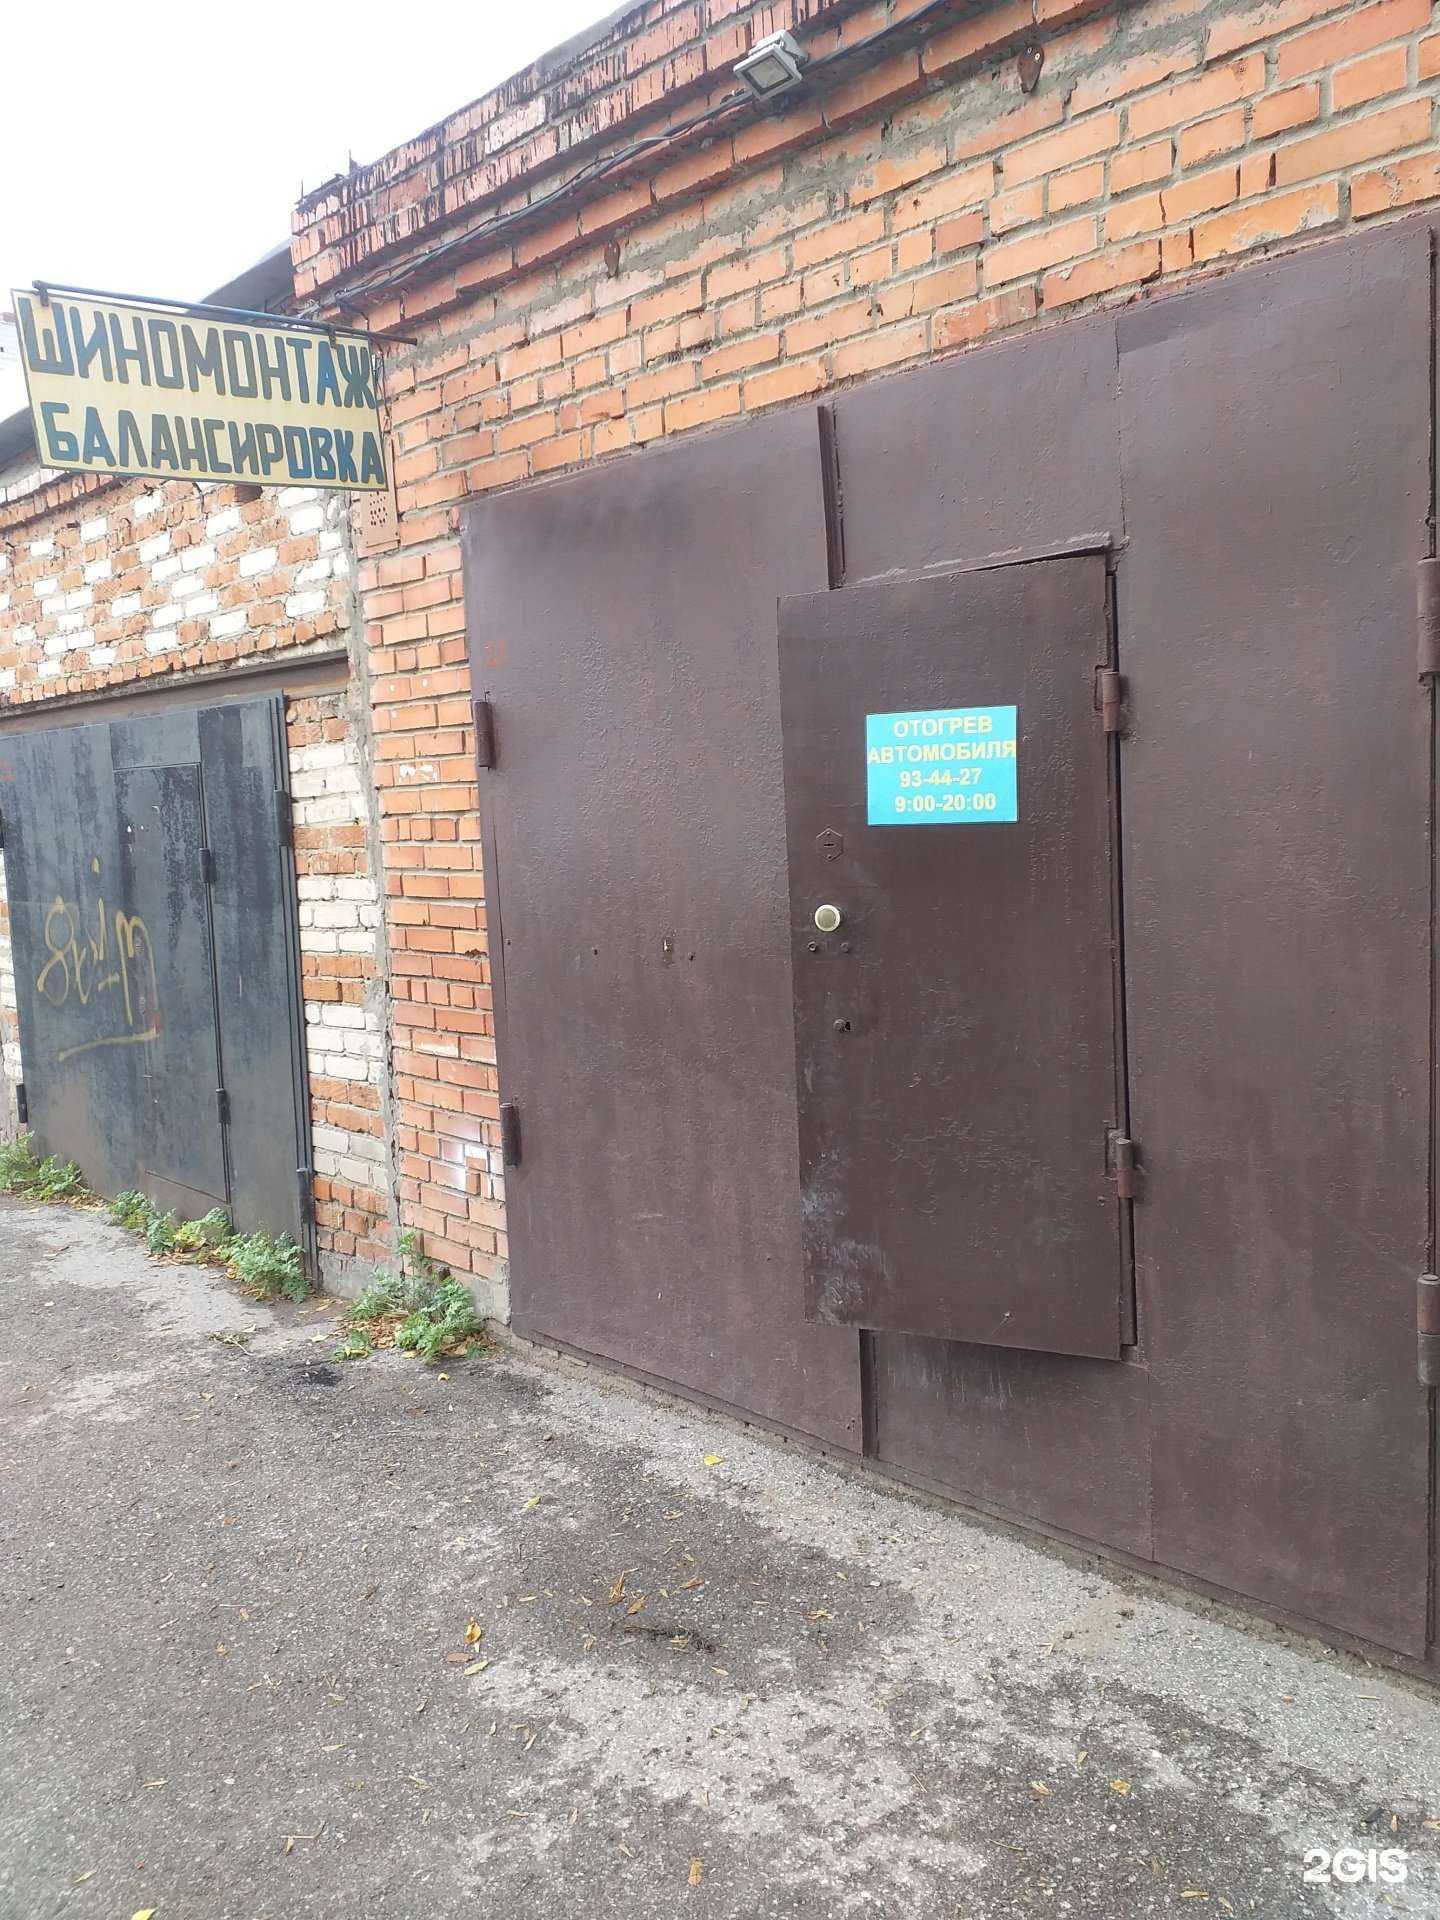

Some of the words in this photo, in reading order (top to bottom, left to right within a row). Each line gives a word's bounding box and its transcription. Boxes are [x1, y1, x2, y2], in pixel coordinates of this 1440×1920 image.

[17, 297, 375, 409] ШИНОМОНТАЖ
[40, 401, 384, 484] БАЛАНСИРОВКА
[894, 715, 993, 738] ОТОГРЕВ
[867, 740, 1016, 764] АВТОМОБИЛЯ
[900, 767, 983, 788] 93-44-27
[895, 793, 996, 812] 9:00-20:00
